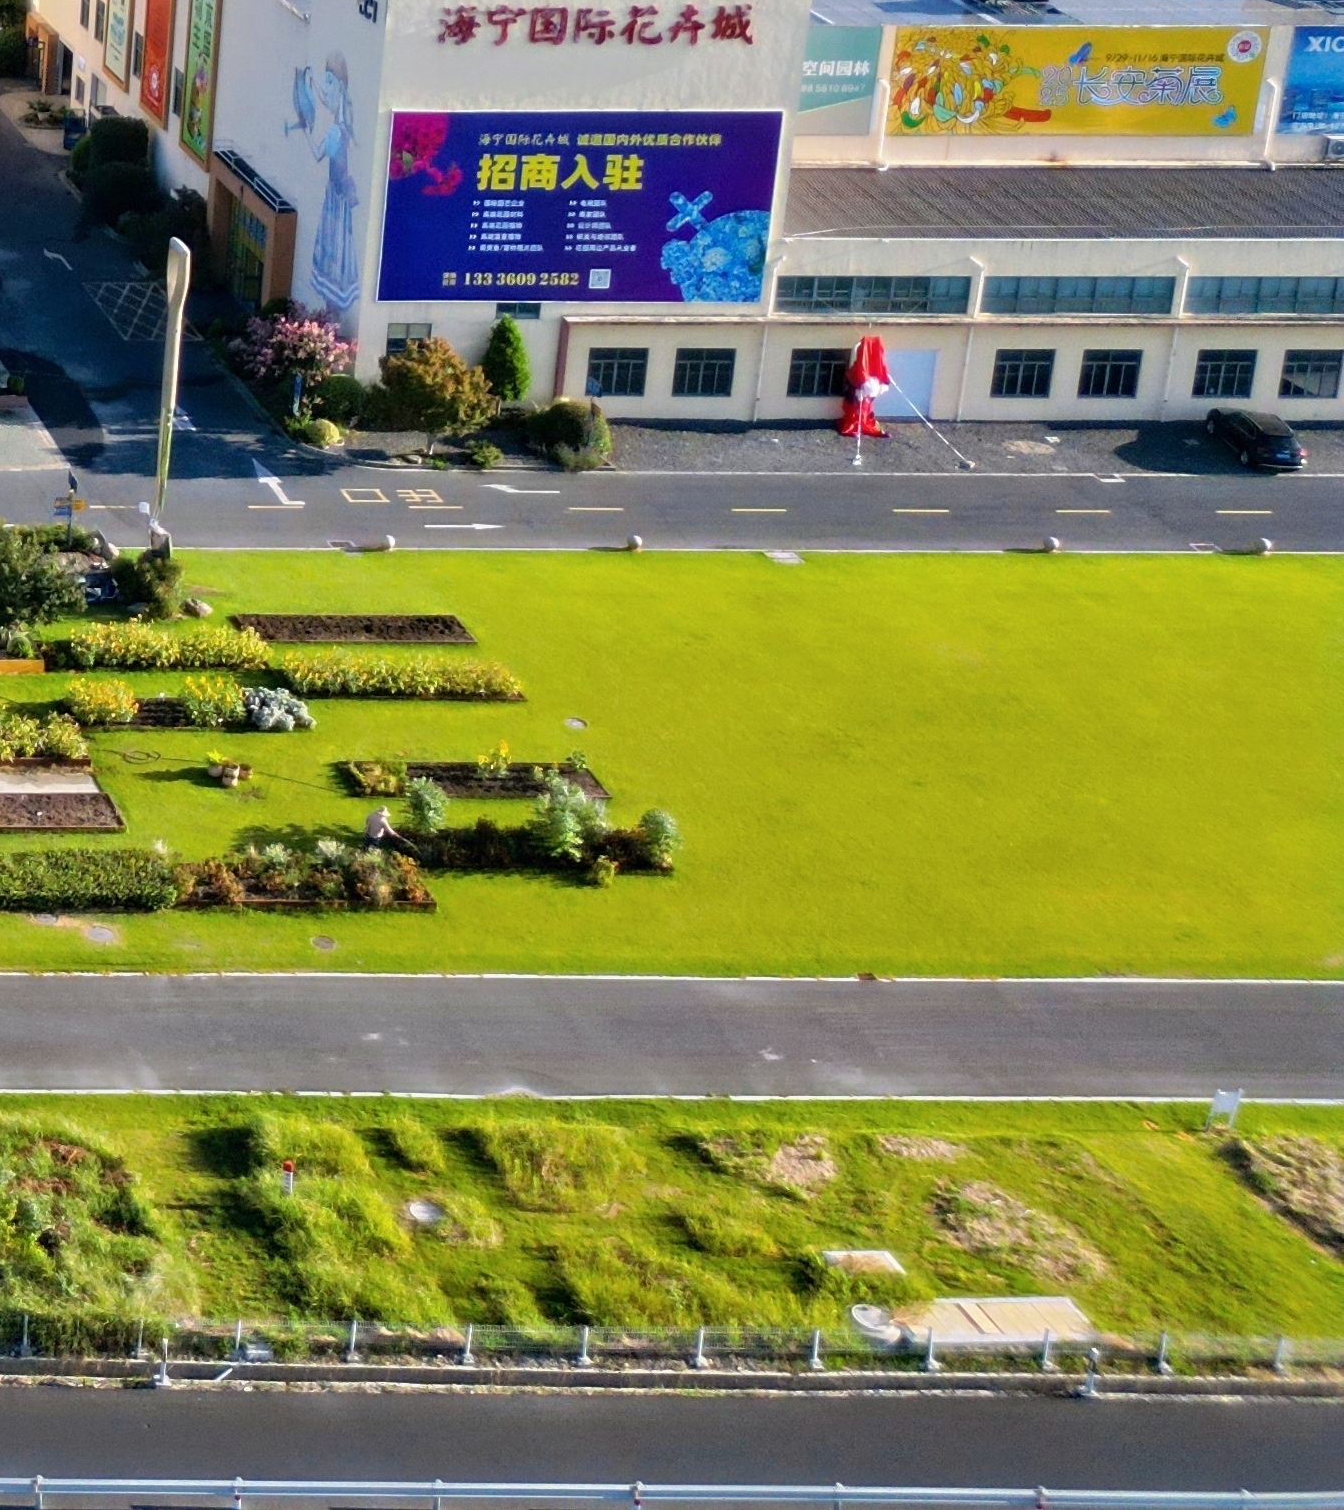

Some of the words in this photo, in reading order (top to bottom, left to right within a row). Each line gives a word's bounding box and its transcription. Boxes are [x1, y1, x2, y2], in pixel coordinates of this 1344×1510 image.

[438, 3, 753, 46] 海宁国际花卉城
[802, 60, 870, 77] 空间园林
[1073, 66, 1224, 106] 长安菊展
[476, 153, 645, 191] 招商入驻
[464, 272, 493, 286] 133
[496, 272, 537, 286] 3609
[539, 272, 580, 286] 2582
